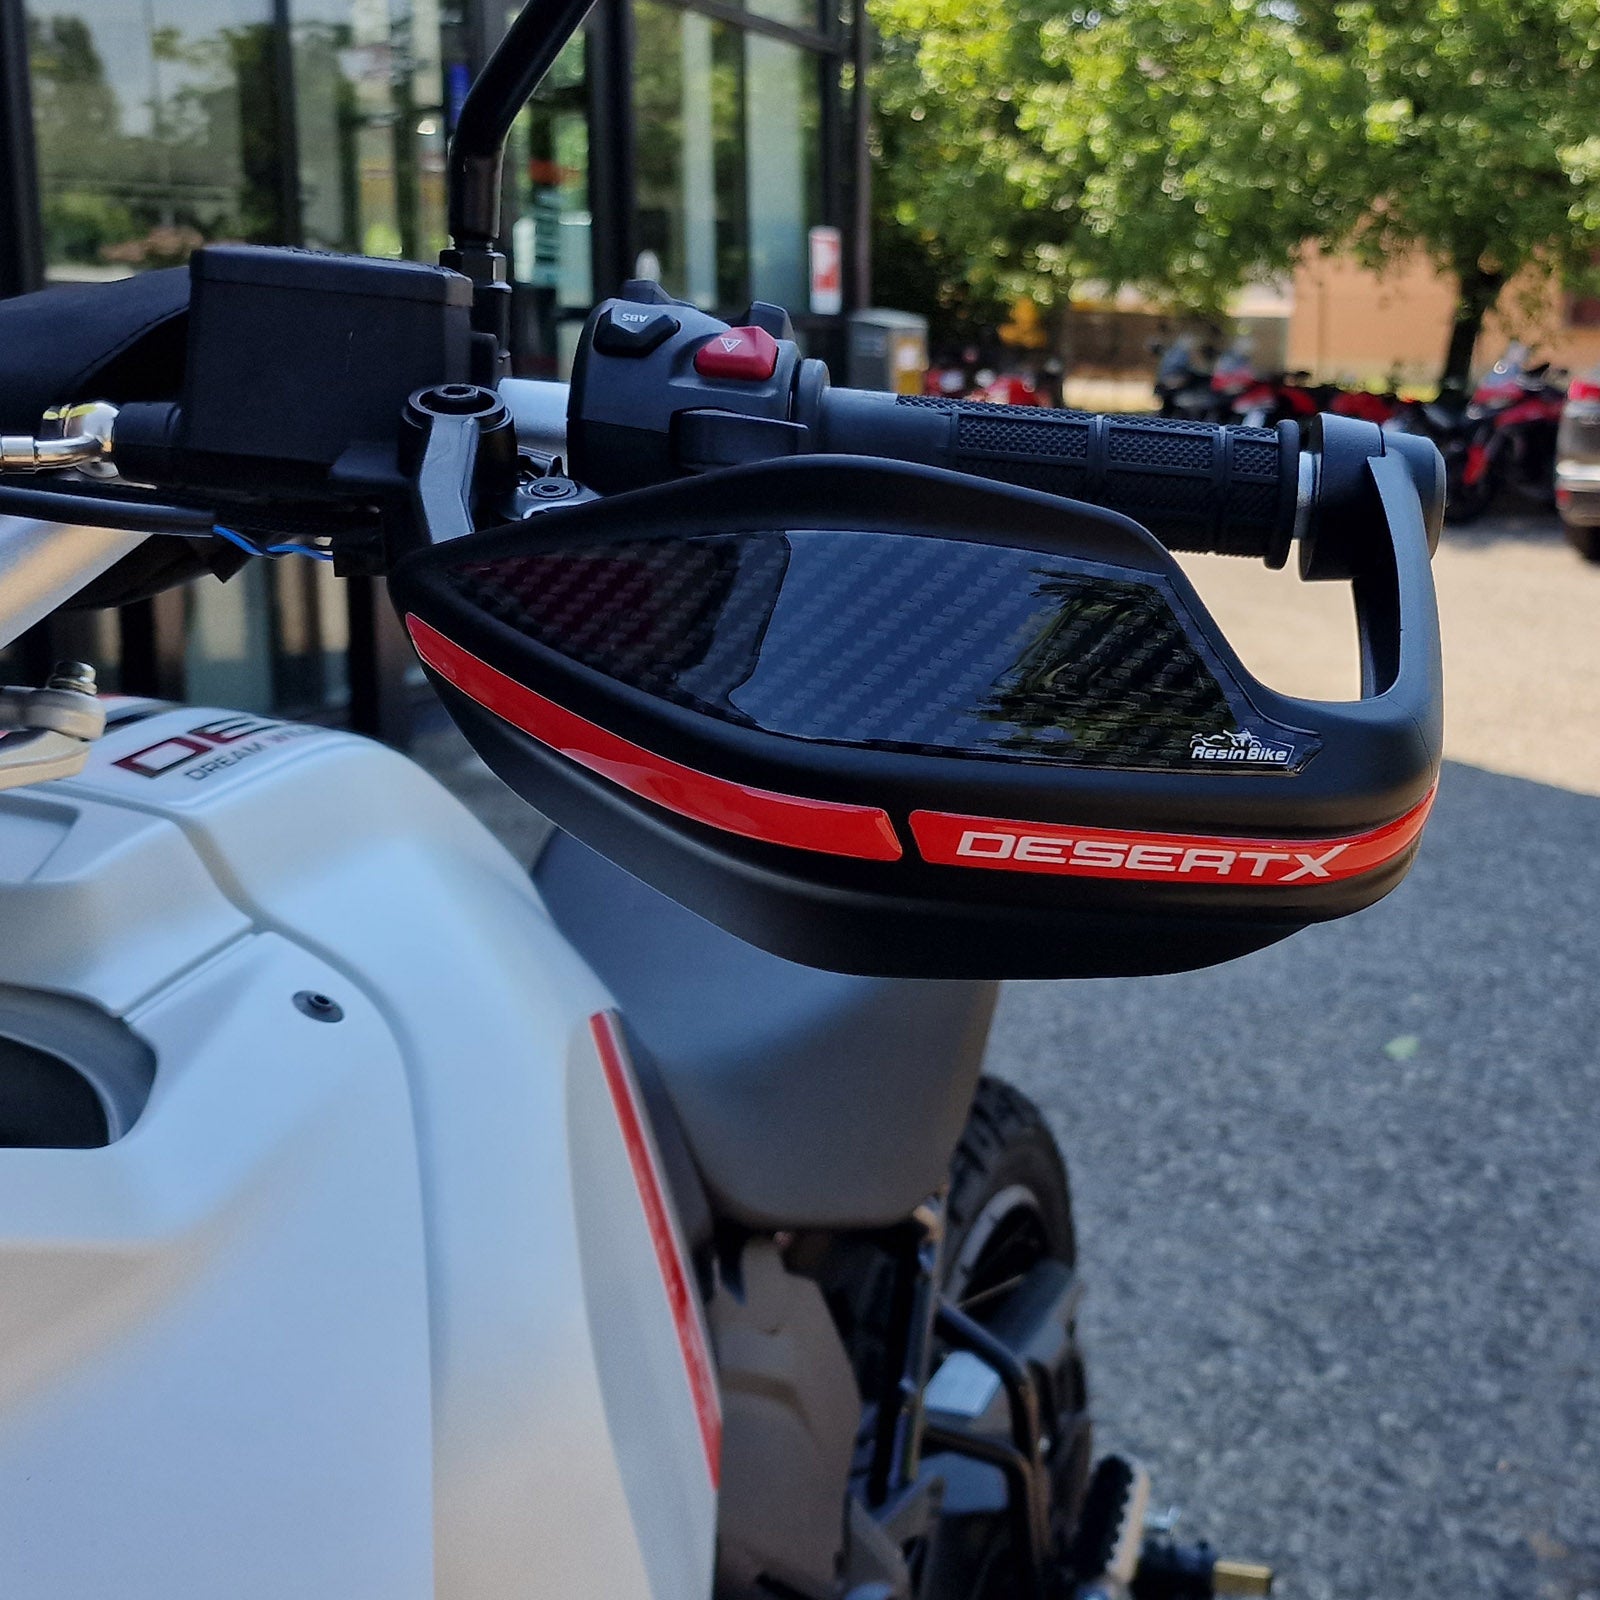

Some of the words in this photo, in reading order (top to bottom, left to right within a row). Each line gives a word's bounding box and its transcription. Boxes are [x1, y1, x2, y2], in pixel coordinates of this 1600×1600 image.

[621, 313, 649, 323] ABS
[184, 742, 266, 781] DREAM
[956, 831, 1352, 881] DESERTX
